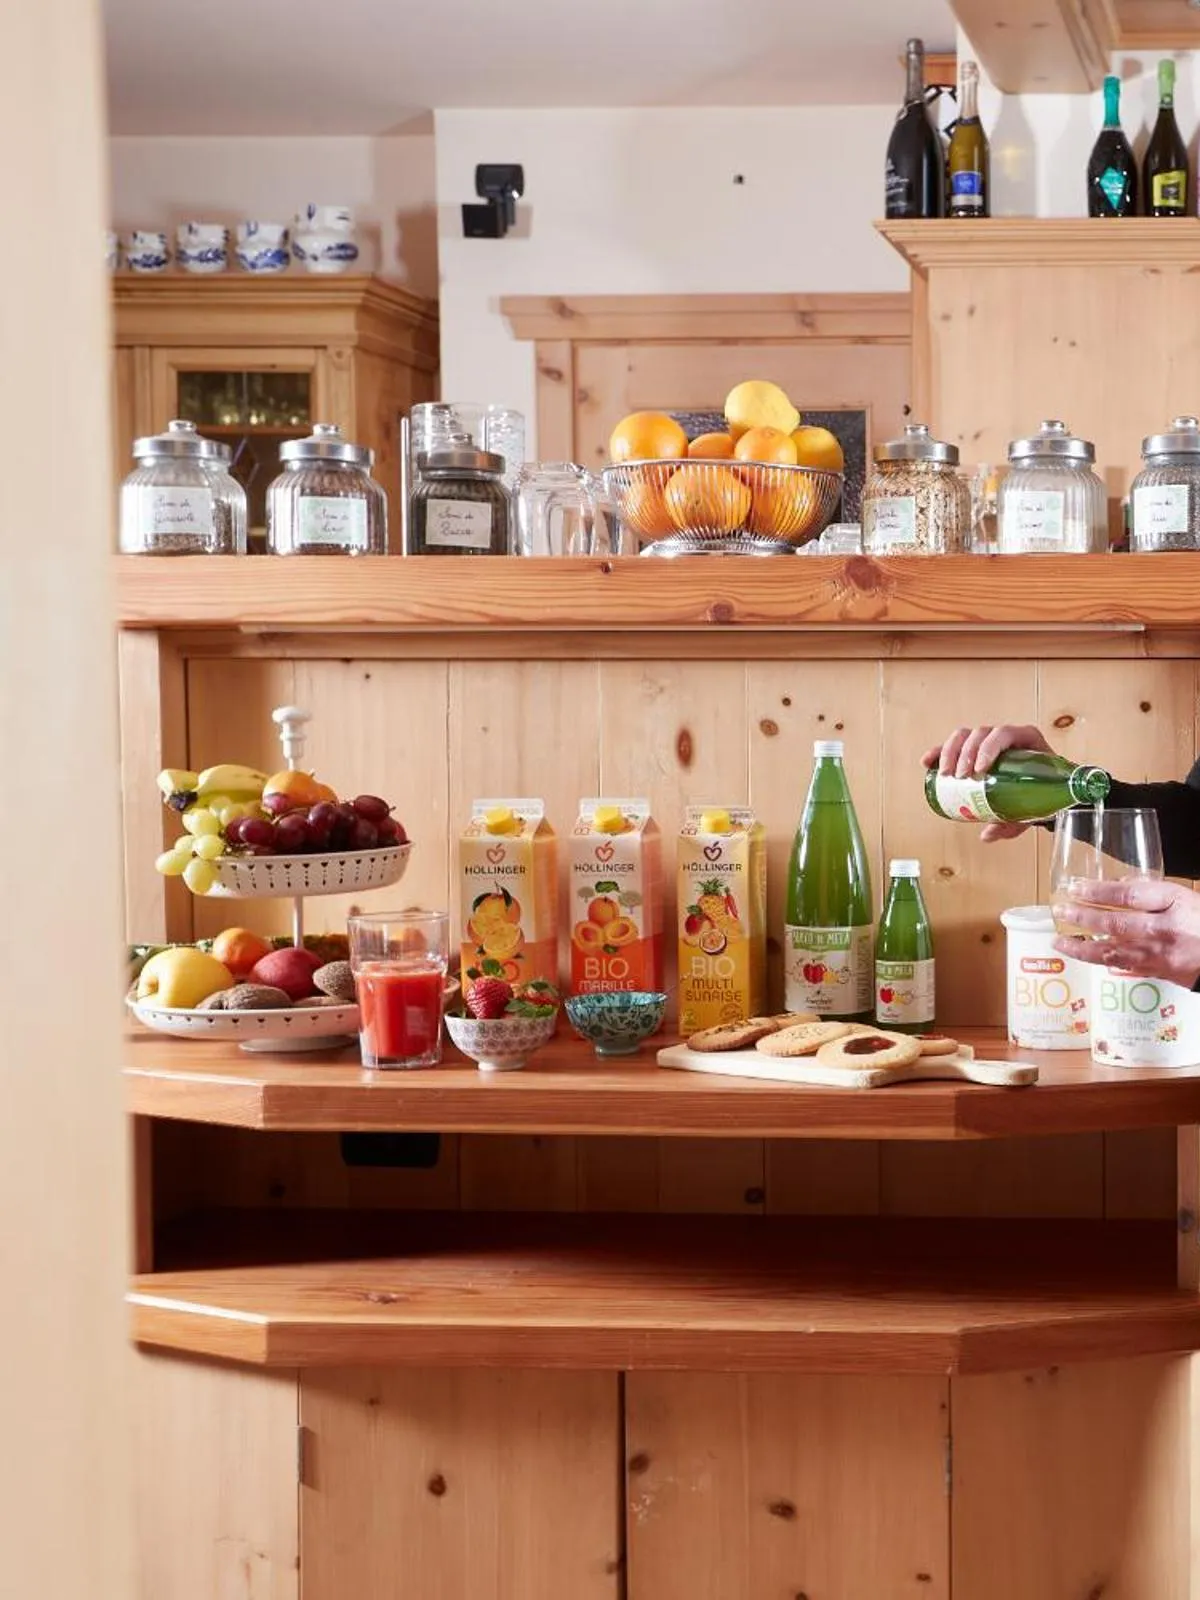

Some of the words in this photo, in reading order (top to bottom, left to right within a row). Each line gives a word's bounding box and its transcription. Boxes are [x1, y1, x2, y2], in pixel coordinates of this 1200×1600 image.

[584, 957, 630, 980] BIO
[691, 956, 736, 978] BIO
[691, 977, 735, 989] MULTI
[1015, 976, 1071, 1008] BIO
[685, 990, 743, 1002] SUNRISE
[1101, 980, 1160, 1014] BIO
